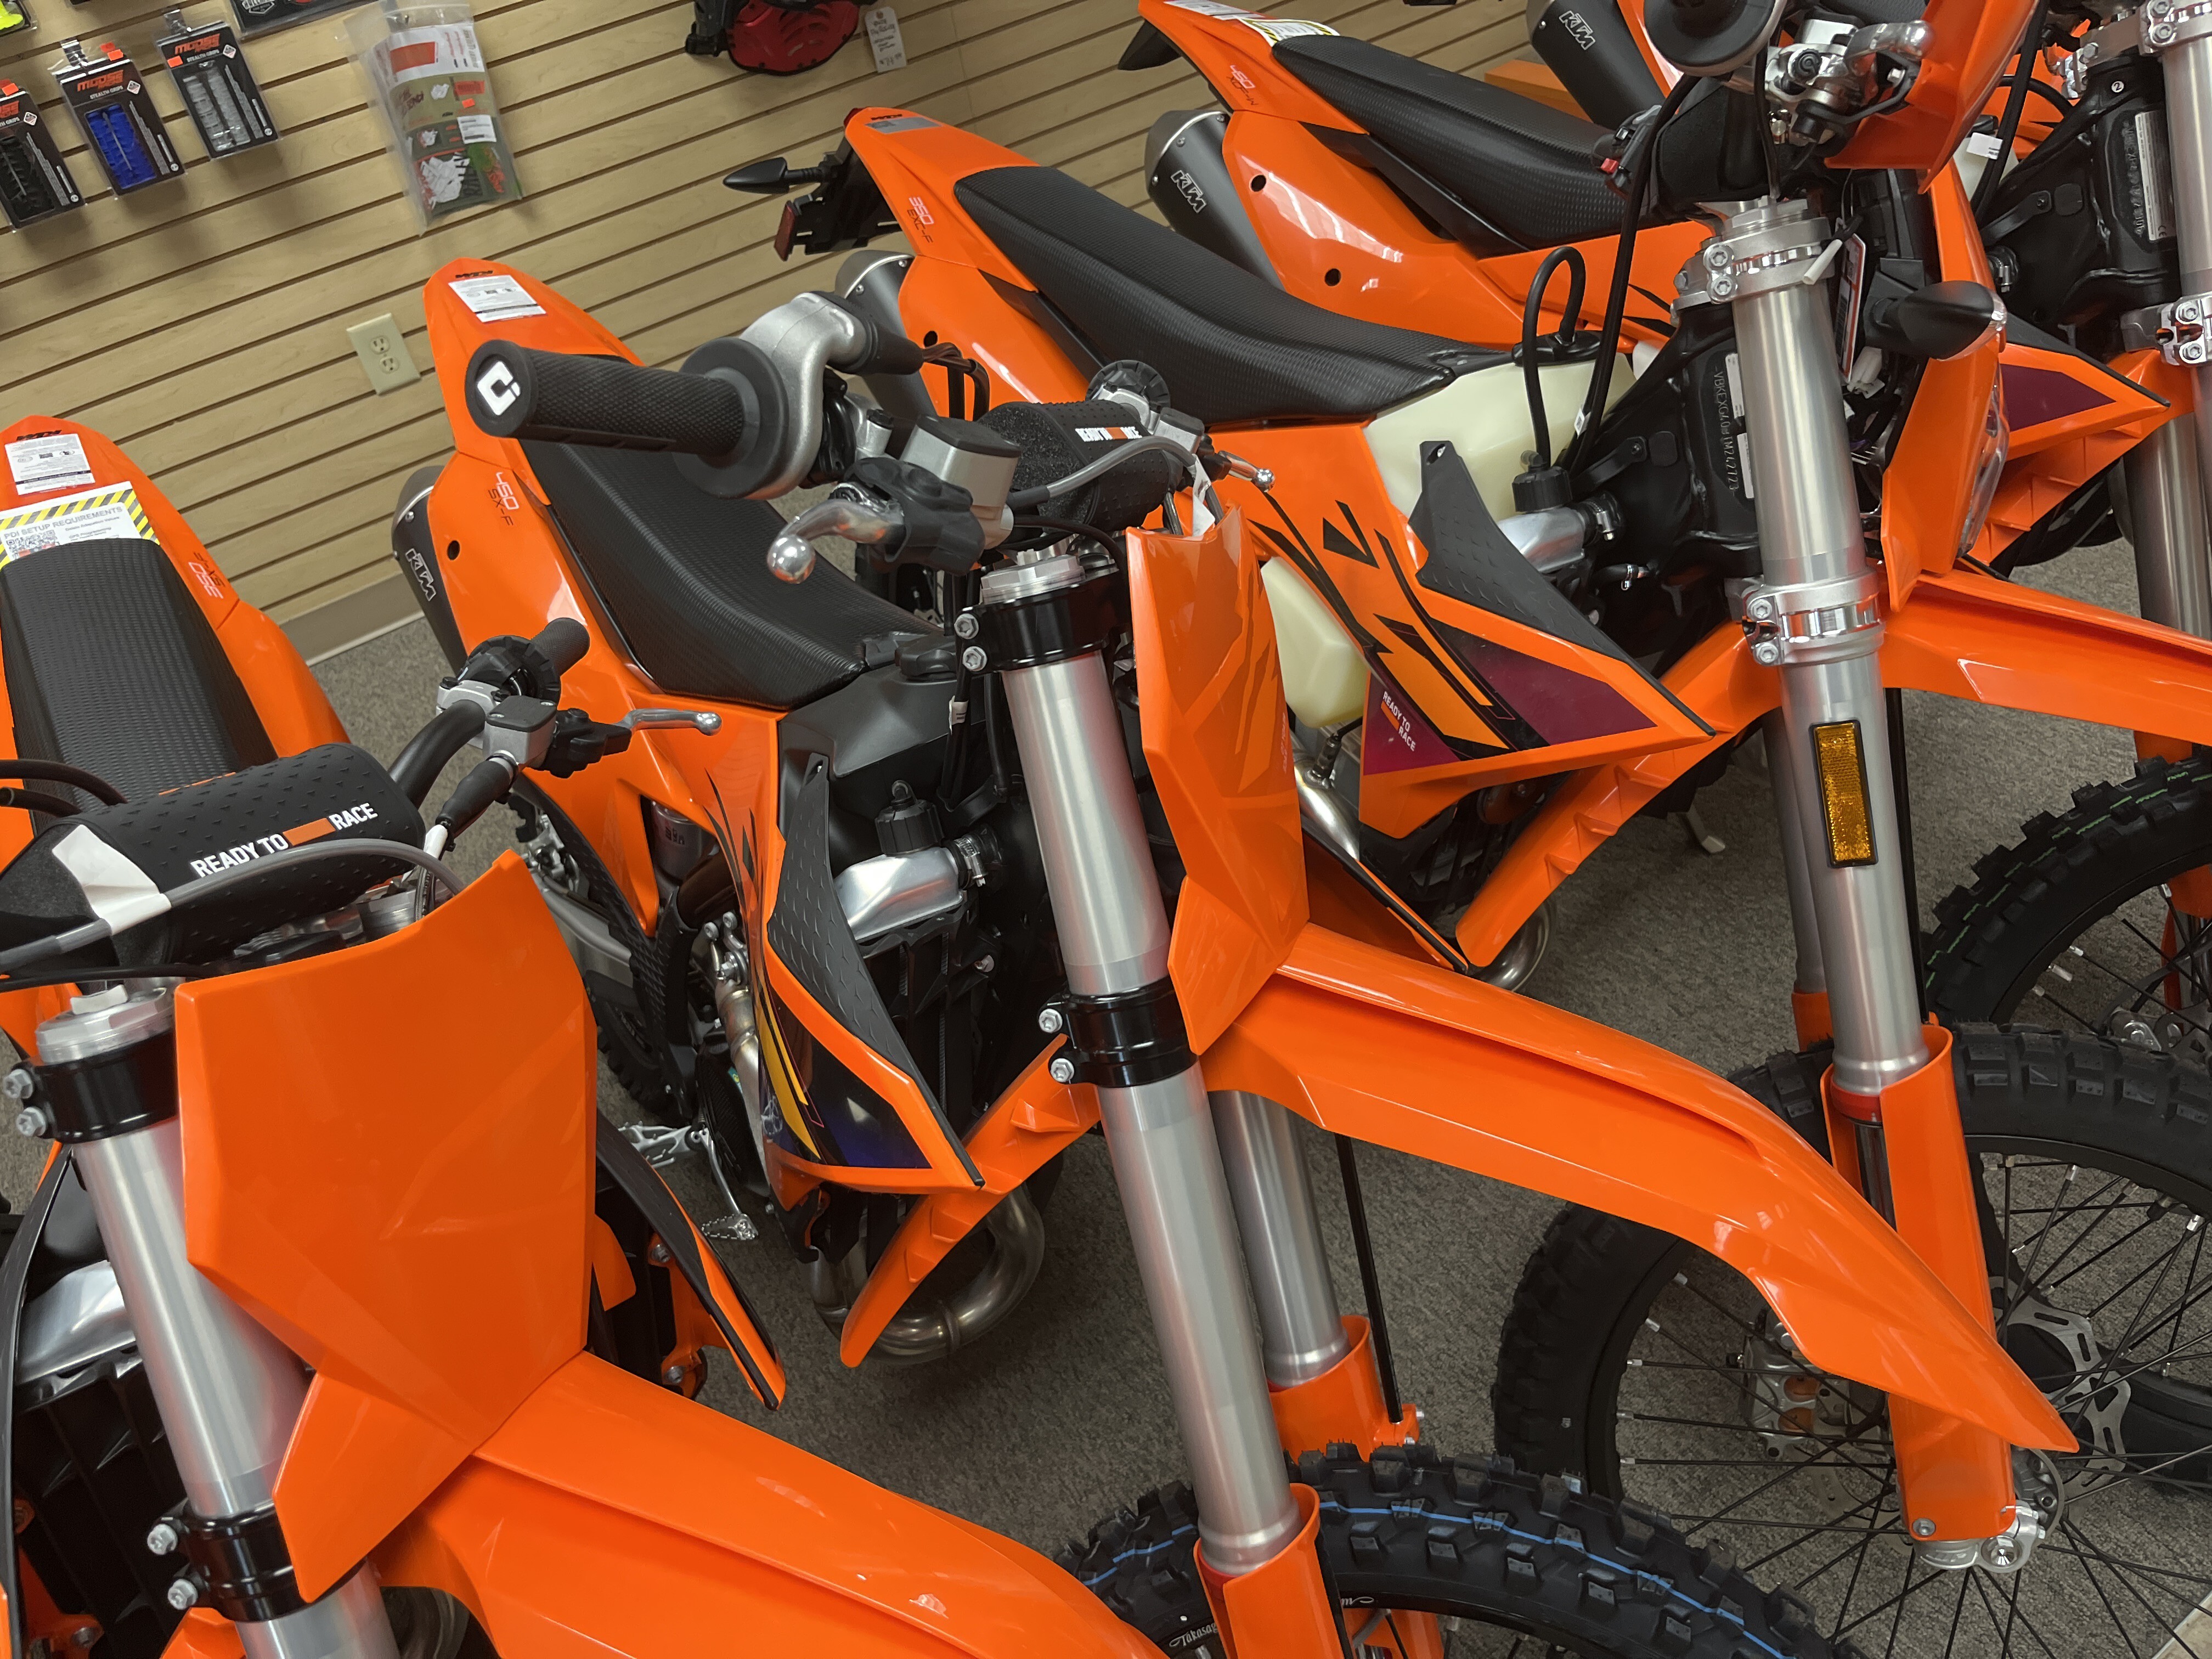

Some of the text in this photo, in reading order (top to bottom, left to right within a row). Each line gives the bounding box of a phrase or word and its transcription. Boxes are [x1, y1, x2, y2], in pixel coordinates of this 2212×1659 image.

[1559, 10, 1596, 50] KTM
[1230, 65, 1255, 89] 450
[1171, 170, 1206, 213] KTM
[907, 208, 933, 243] EXC-F
[909, 196, 934, 225] 350
[488, 489, 514, 526] SX-F
[496, 472, 519, 510] 450
[4, 506, 123, 539] PDI SETUP REQUIREMENTS
[188, 561, 224, 599] 350
[405, 548, 437, 602] KTM
[1383, 691, 1410, 732] READY TO
[1398, 726, 1417, 752] RACE
[190, 802, 379, 878] READY TO RACE
[1169, 1622, 1218, 1647] Takasag
